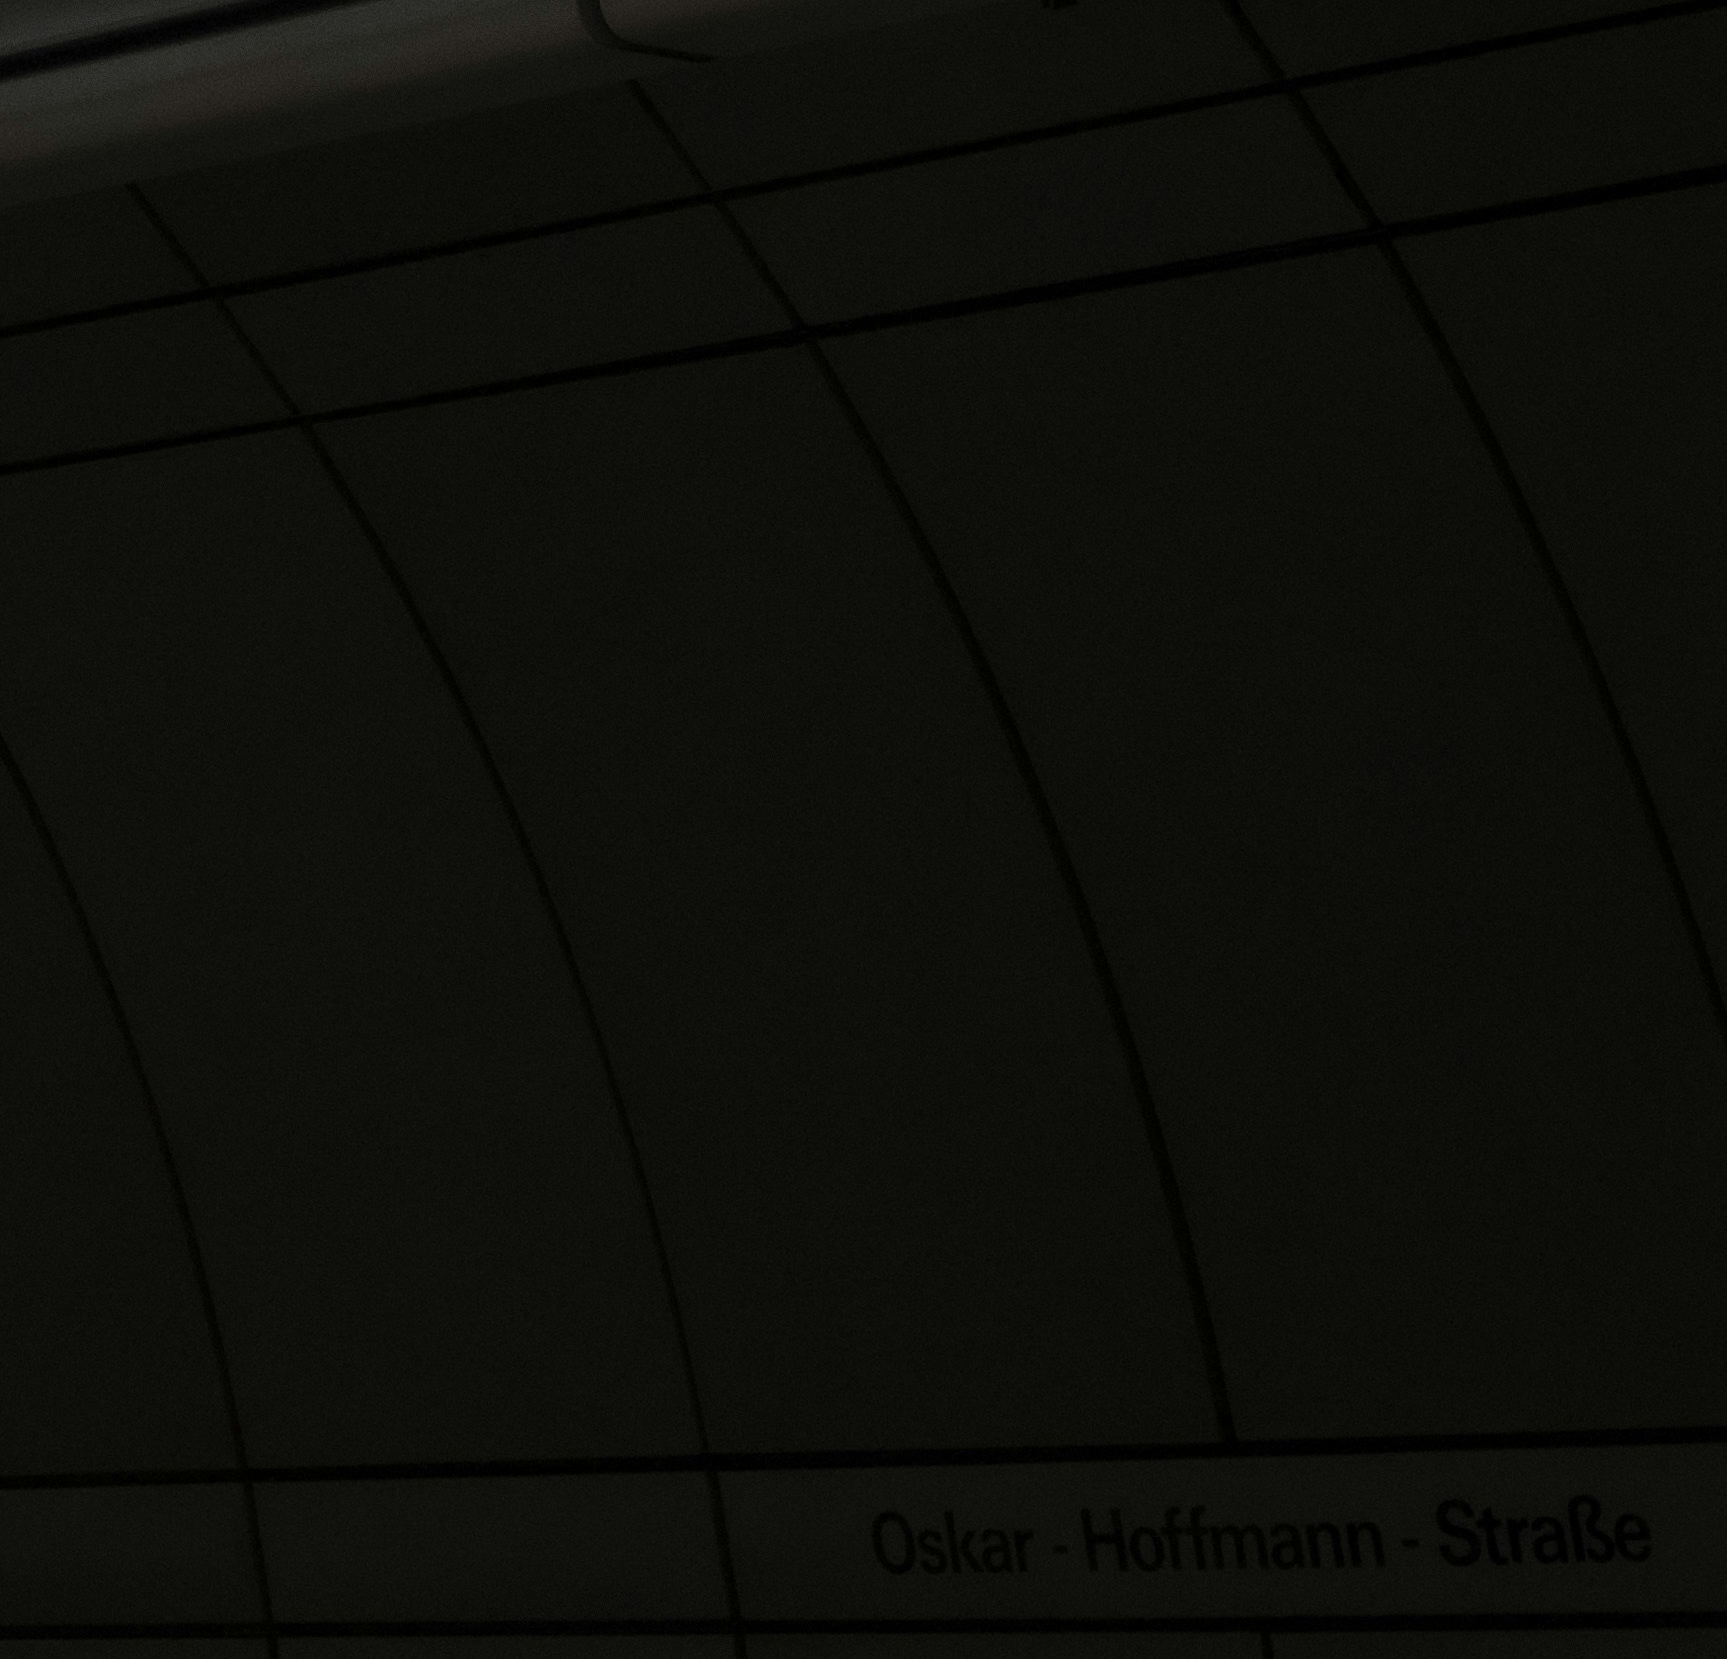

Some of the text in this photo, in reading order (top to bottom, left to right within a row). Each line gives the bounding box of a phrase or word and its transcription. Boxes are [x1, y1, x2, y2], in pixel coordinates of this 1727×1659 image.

[871, 1509, 1035, 1575] Oskar
[1079, 1505, 1387, 1574] Hoffmann
[1434, 1493, 1654, 1567] Straße
